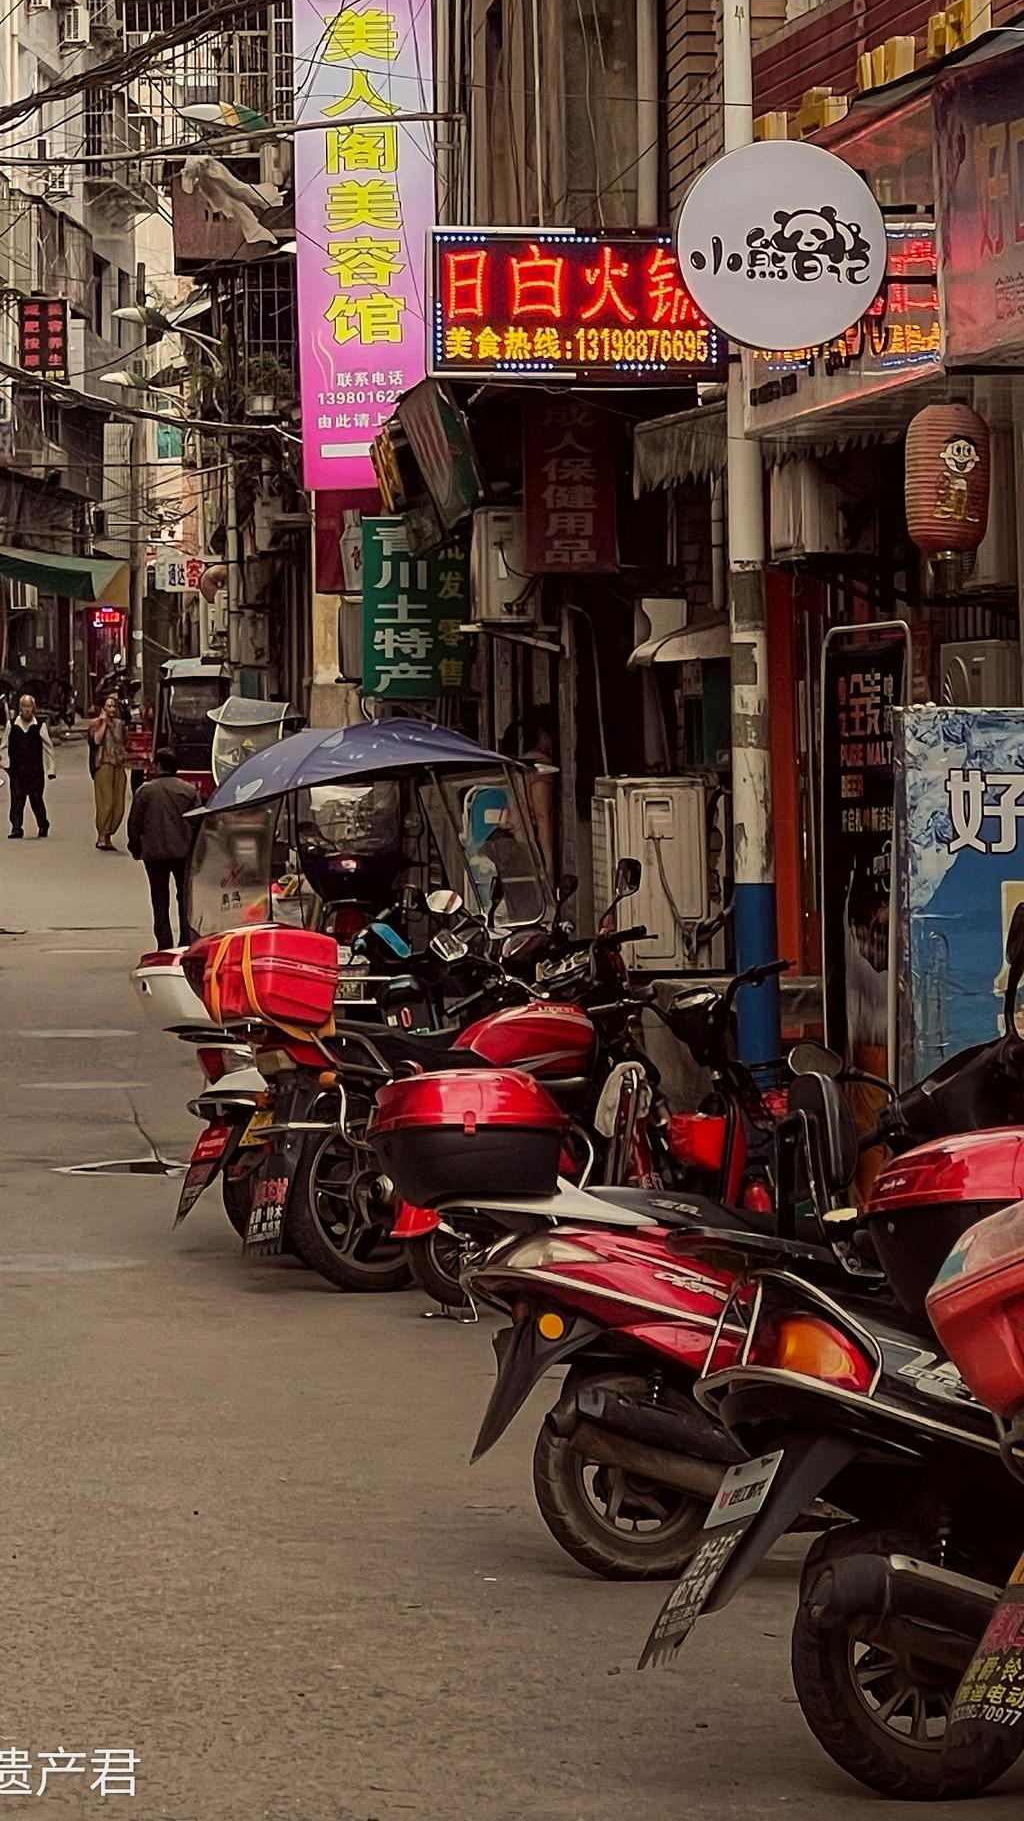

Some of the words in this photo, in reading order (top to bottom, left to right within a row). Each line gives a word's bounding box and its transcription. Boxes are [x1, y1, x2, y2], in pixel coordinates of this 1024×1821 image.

[320, 9, 407, 346] 美人阁美容馆
[336, 370, 405, 388] 联系电话
[540, 402, 598, 565] 成人保健用品
[944, 766, 1024, 856] 好
